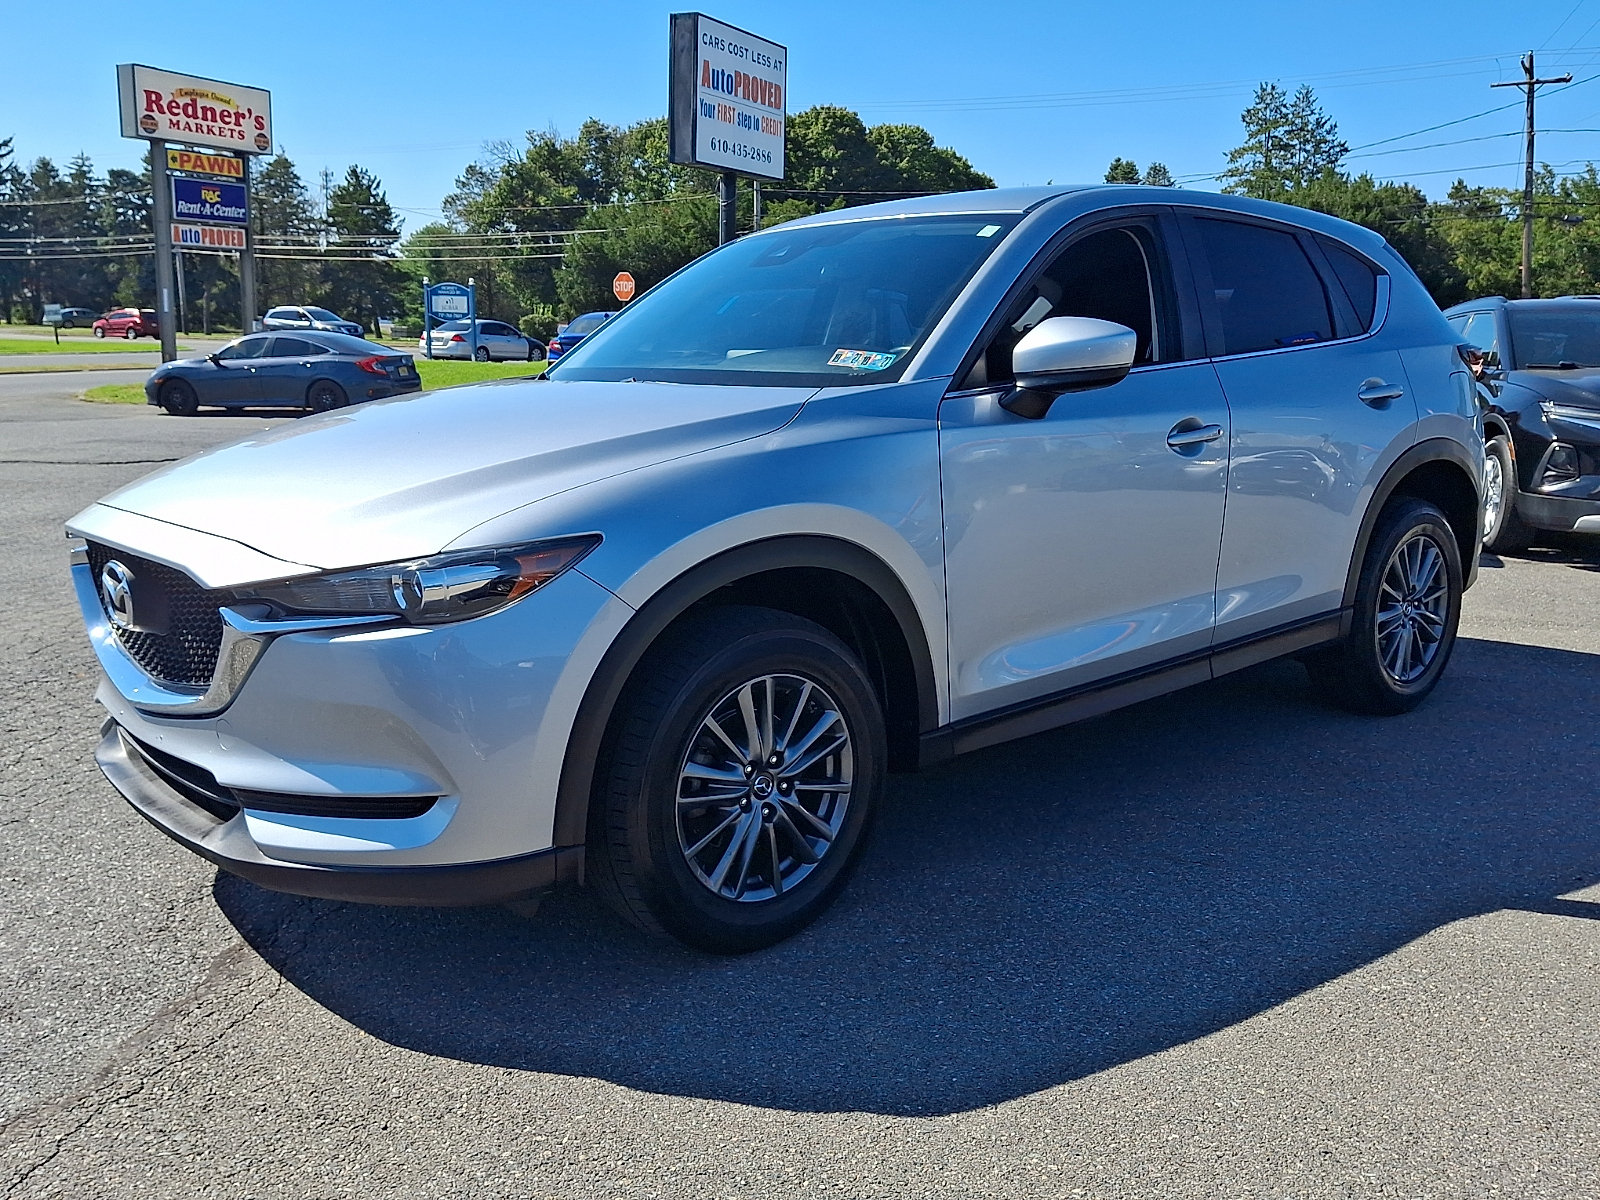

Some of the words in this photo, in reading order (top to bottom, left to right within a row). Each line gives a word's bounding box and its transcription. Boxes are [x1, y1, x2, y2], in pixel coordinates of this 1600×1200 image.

[702, 33, 725, 51] CARS
[727, 43, 749, 60] COST
[751, 51, 771, 68] LESS
[773, 60, 782, 72] AT
[701, 60, 782, 110] AutoPROVED
[143, 89, 265, 131] Redner's
[699, 97, 716, 118] Your
[717, 102, 736, 125] FIRST
[737, 110, 751, 131] step
[753, 114, 760, 132] to
[761, 115, 782, 137] CREDIT
[168, 118, 246, 140] MARKETS
[179, 153, 241, 175] PAWN
[173, 225, 244, 247] AutoPROVED
[615, 281, 633, 292] STOP
